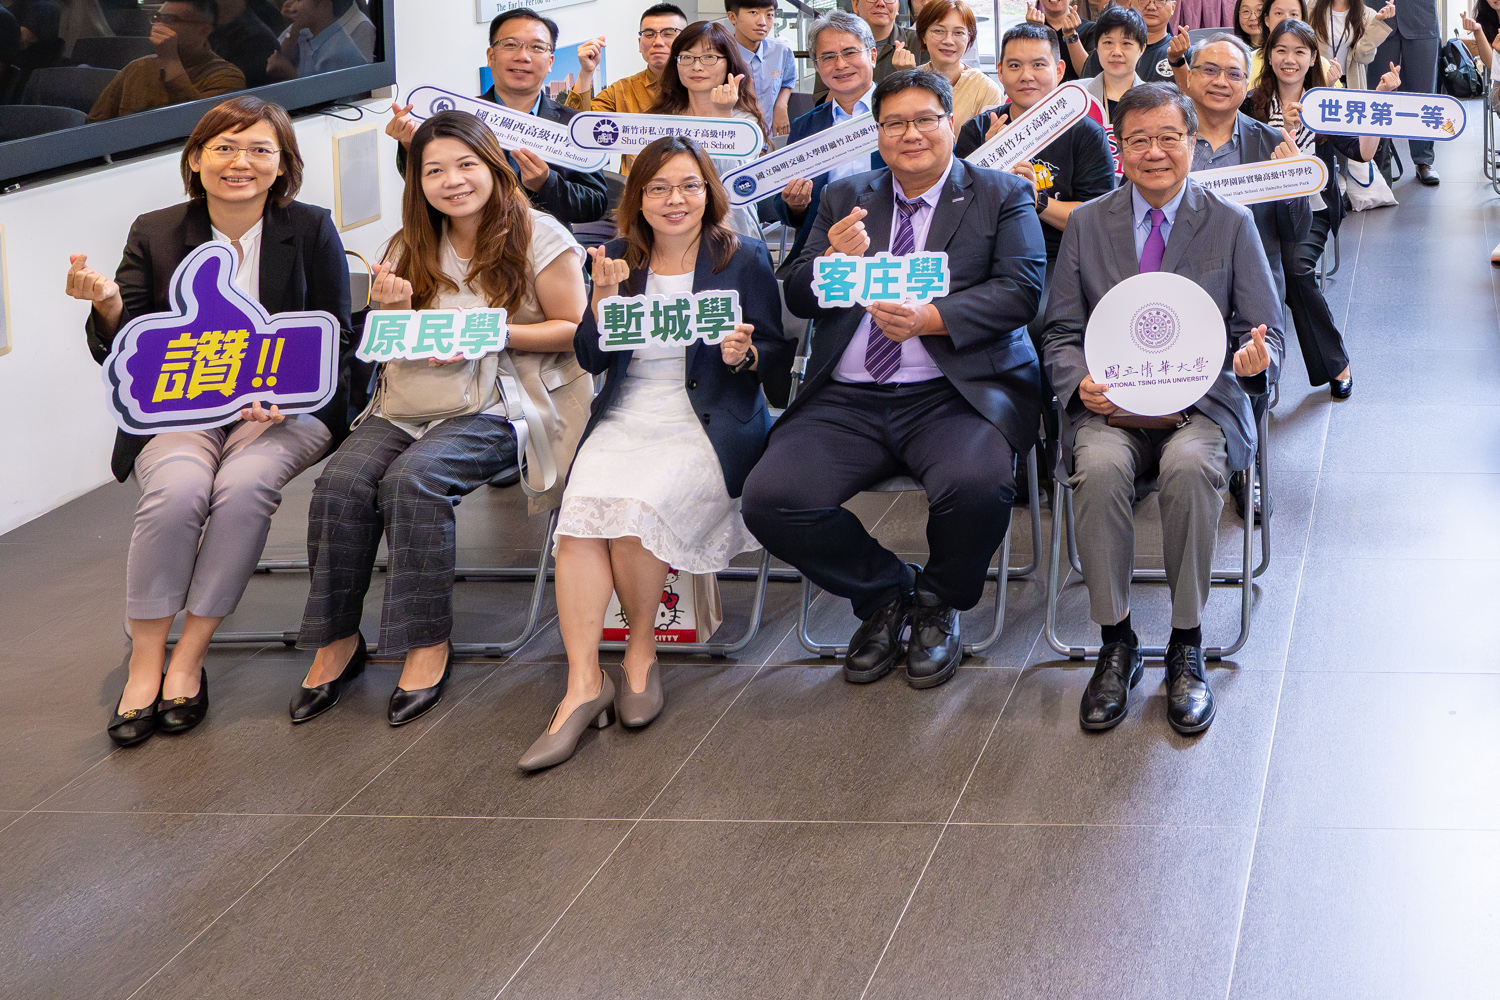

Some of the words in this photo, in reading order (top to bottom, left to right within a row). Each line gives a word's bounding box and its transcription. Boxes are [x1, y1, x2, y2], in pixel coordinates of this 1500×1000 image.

[496, 3, 507, 12] The
[508, 0, 524, 10] Early
[1318, 98, 1445, 130] 世界第一等
[493, 130, 518, 143] uan-Hsi
[520, 138, 543, 150] Senior
[545, 145, 563, 156] High
[564, 151, 588, 164] School
[621, 125, 736, 139] 新竹市私立曙光女子高級中學
[621, 136, 637, 145] Shu
[638, 137, 653, 146] Gua
[710, 141, 735, 150] School
[976, 97, 1067, 168] 國立新竹女子高級中學
[1004, 150, 1024, 167] Hsinchu
[1034, 129, 1050, 143] Senior
[1049, 120, 1061, 131] High
[1060, 108, 1076, 122] School
[755, 125, 876, 181] 國立陽明交通大學附屬竹北高級中
[1200, 166, 1312, 189] 竹科學園區實驗高級中等學校
[817, 257, 945, 303] 客庄學
[362, 312, 501, 356] 原民學
[603, 296, 736, 346] 塹城學
[1104, 356, 1209, 380] 國立清華大學
[1172, 375, 1209, 383] UNIVERSITY
